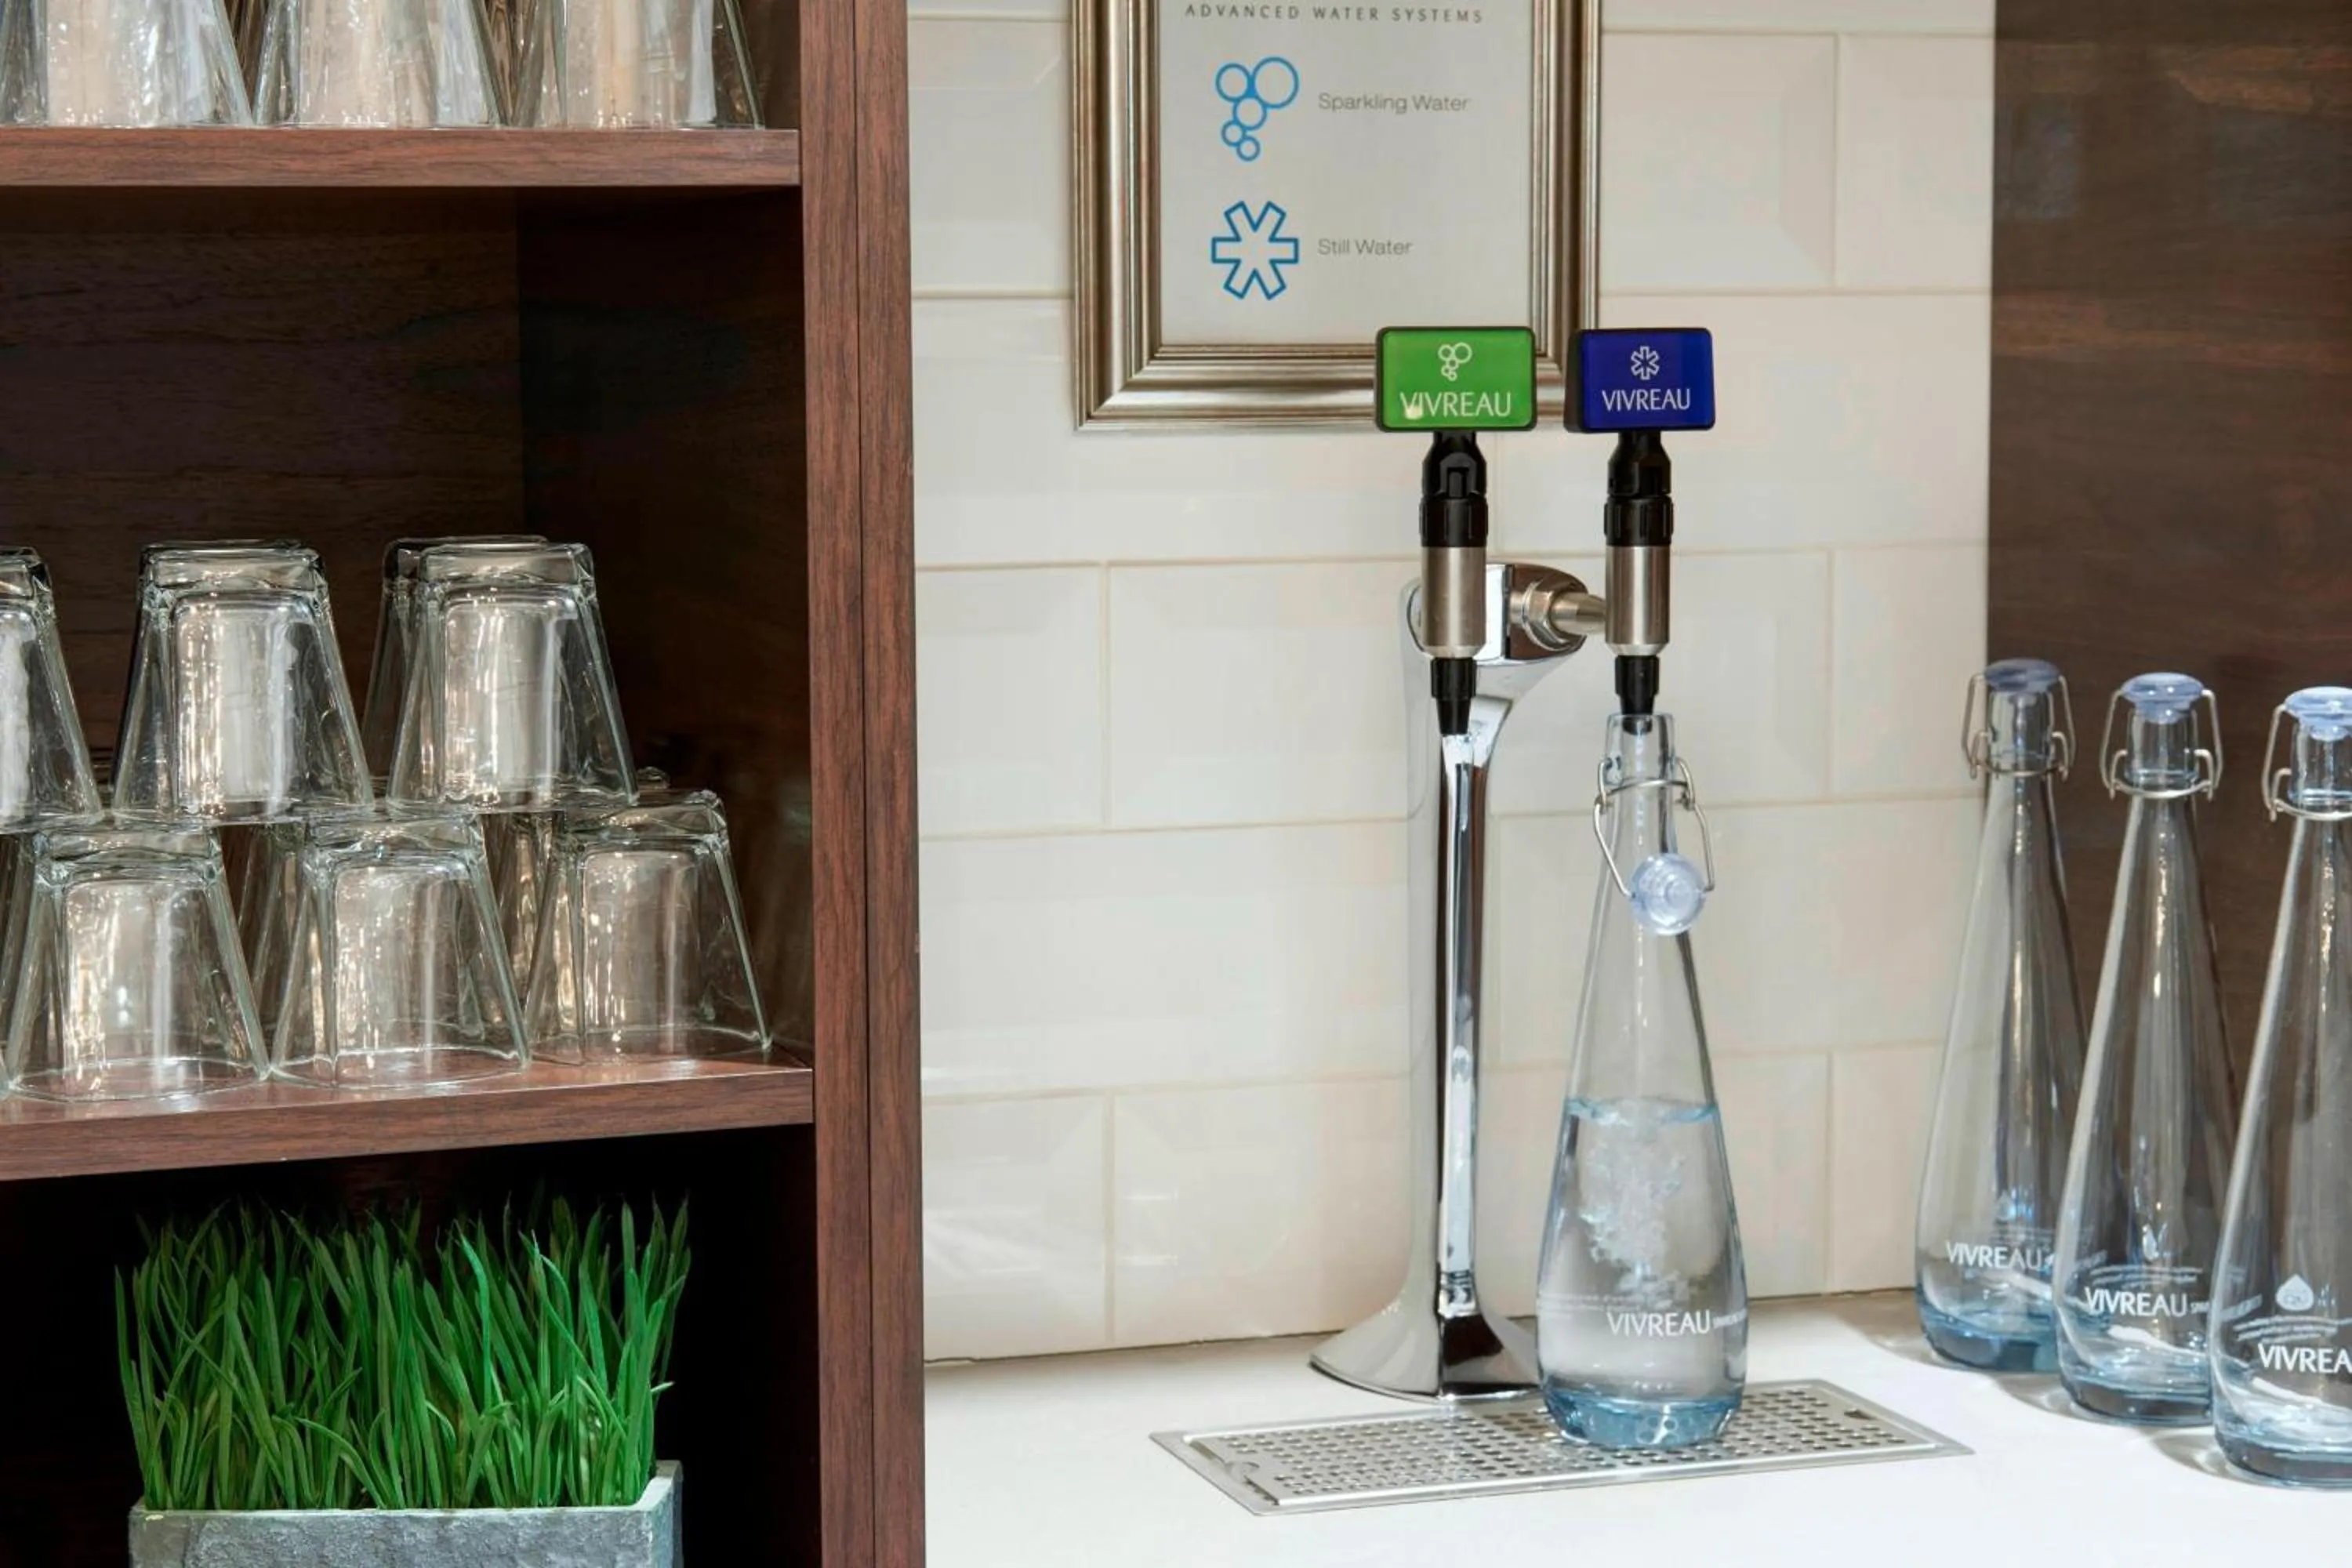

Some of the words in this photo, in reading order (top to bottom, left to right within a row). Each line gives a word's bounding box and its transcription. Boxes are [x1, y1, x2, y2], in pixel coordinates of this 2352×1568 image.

[1185, 5, 1300, 20] ADVANCED
[1312, 6, 1379, 22] WATER
[1391, 8, 1483, 24] SYSTEMS
[1318, 92, 1408, 114] Sparkling
[1410, 94, 1469, 111] Water
[1317, 238, 1350, 256] Still
[1354, 239, 1413, 256] Water
[1399, 392, 1511, 419] VIVREAU
[1602, 389, 1691, 412] VIVREAU
[1945, 1240, 2042, 1270] VIVREAU
[2084, 1286, 2187, 1317] VIVREAU
[1606, 1309, 1711, 1337] VIVREAU
